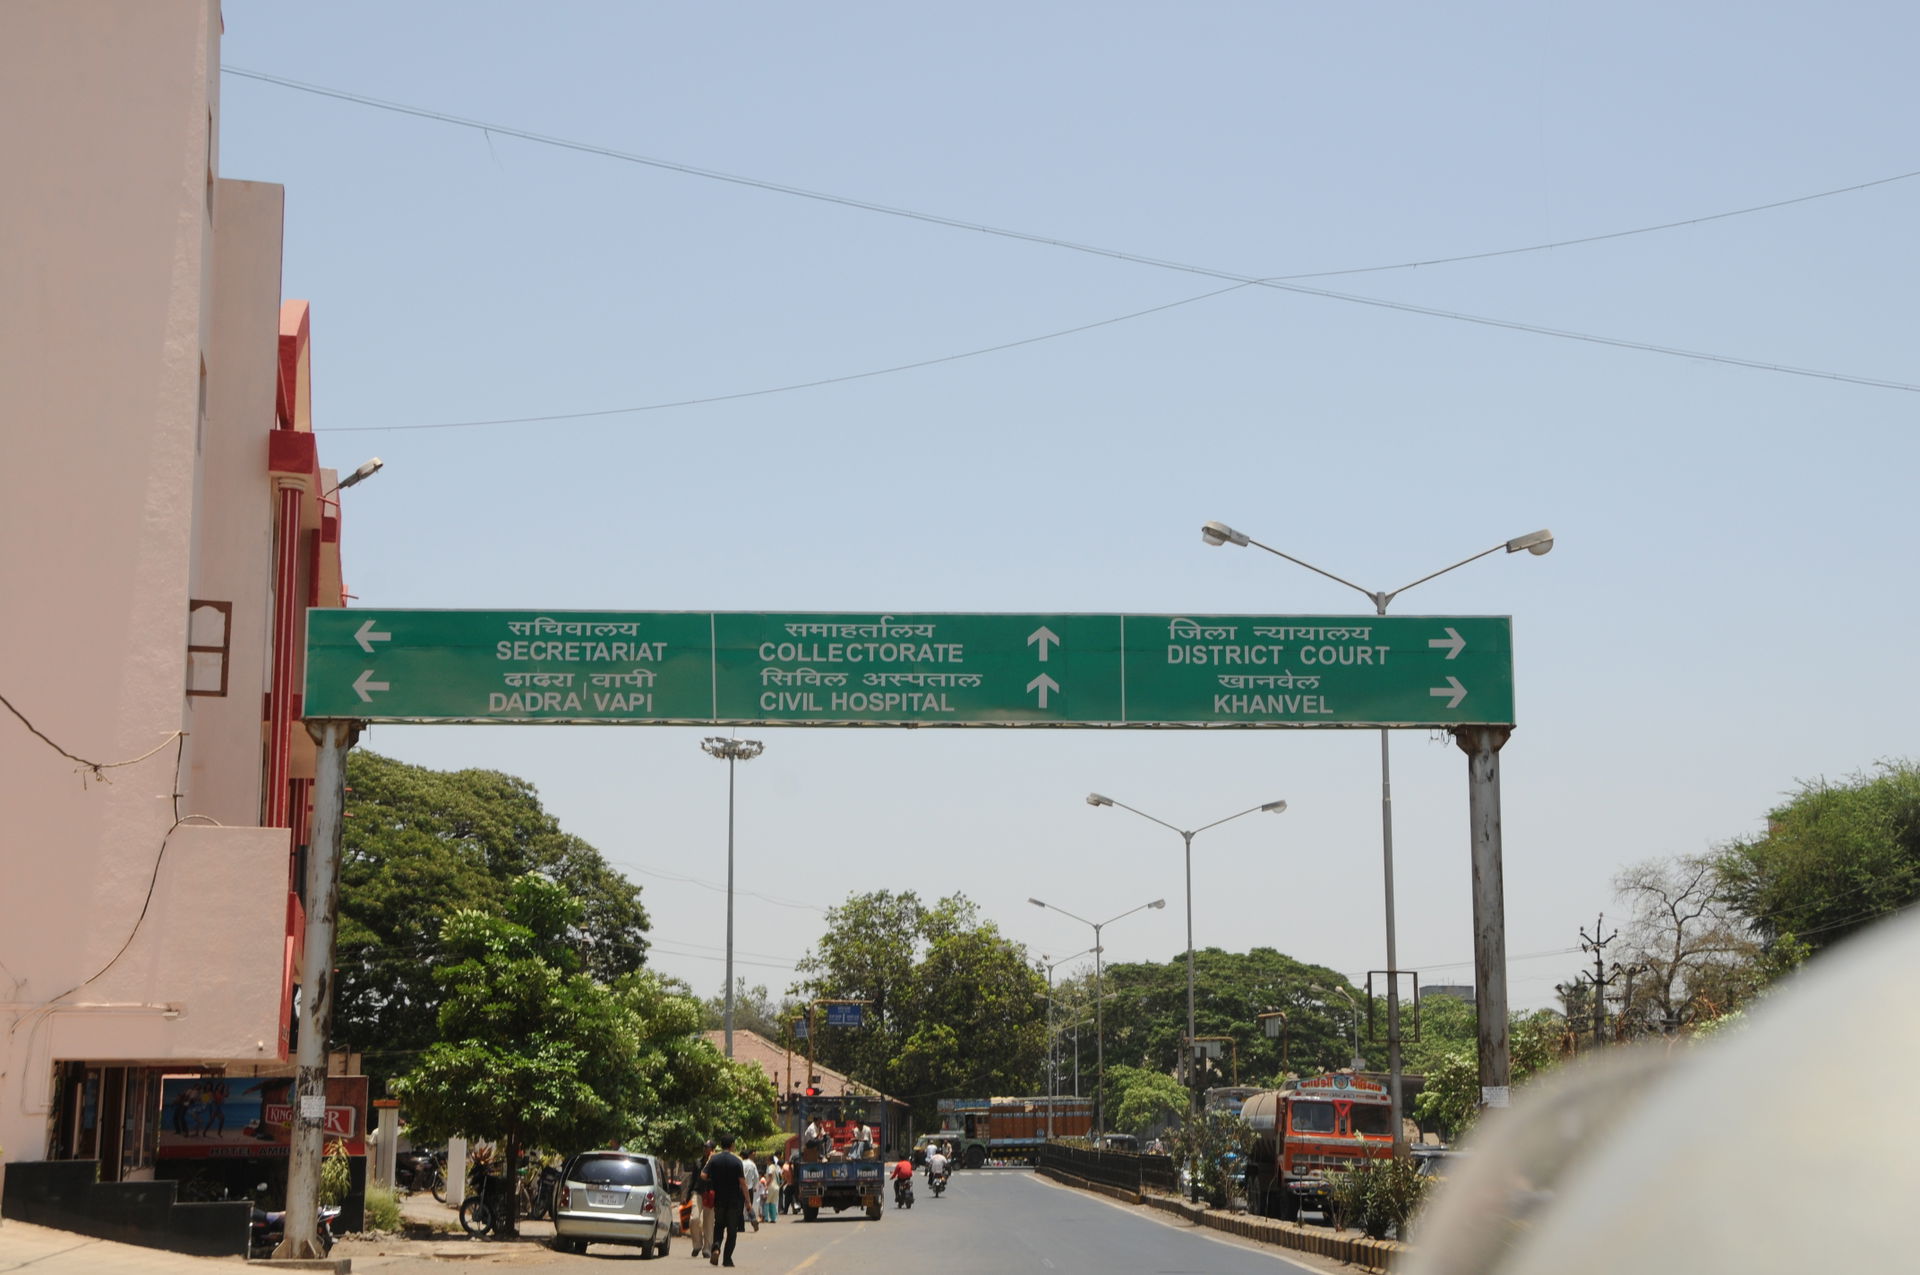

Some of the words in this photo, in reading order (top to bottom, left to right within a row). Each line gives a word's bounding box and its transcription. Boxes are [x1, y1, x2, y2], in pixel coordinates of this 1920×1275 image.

[508, 617, 640, 637] सचिवालय
[785, 615, 936, 638] समाहर्तालय
[1168, 617, 1238, 641] जिला
[1253, 626, 1372, 641] न्यायालय
[496, 641, 667, 662] SECRETARIAT
[759, 643, 963, 663] COLLECTORATE
[1167, 645, 1283, 665] DISTRICT
[1300, 645, 1390, 665] COURT
[503, 672, 575, 688] दादरा
[589, 668, 657, 688] वापी
[760, 667, 848, 687] सिविल
[862, 673, 983, 688] अस्पताल
[1217, 669, 1321, 689] खानवेल
[488, 692, 583, 712] DADRA
[593, 692, 653, 712] VAPI
[760, 692, 823, 712] CIVIL
[831, 692, 955, 712] HOSPITAL
[1214, 694, 1333, 714] KHANVEL
